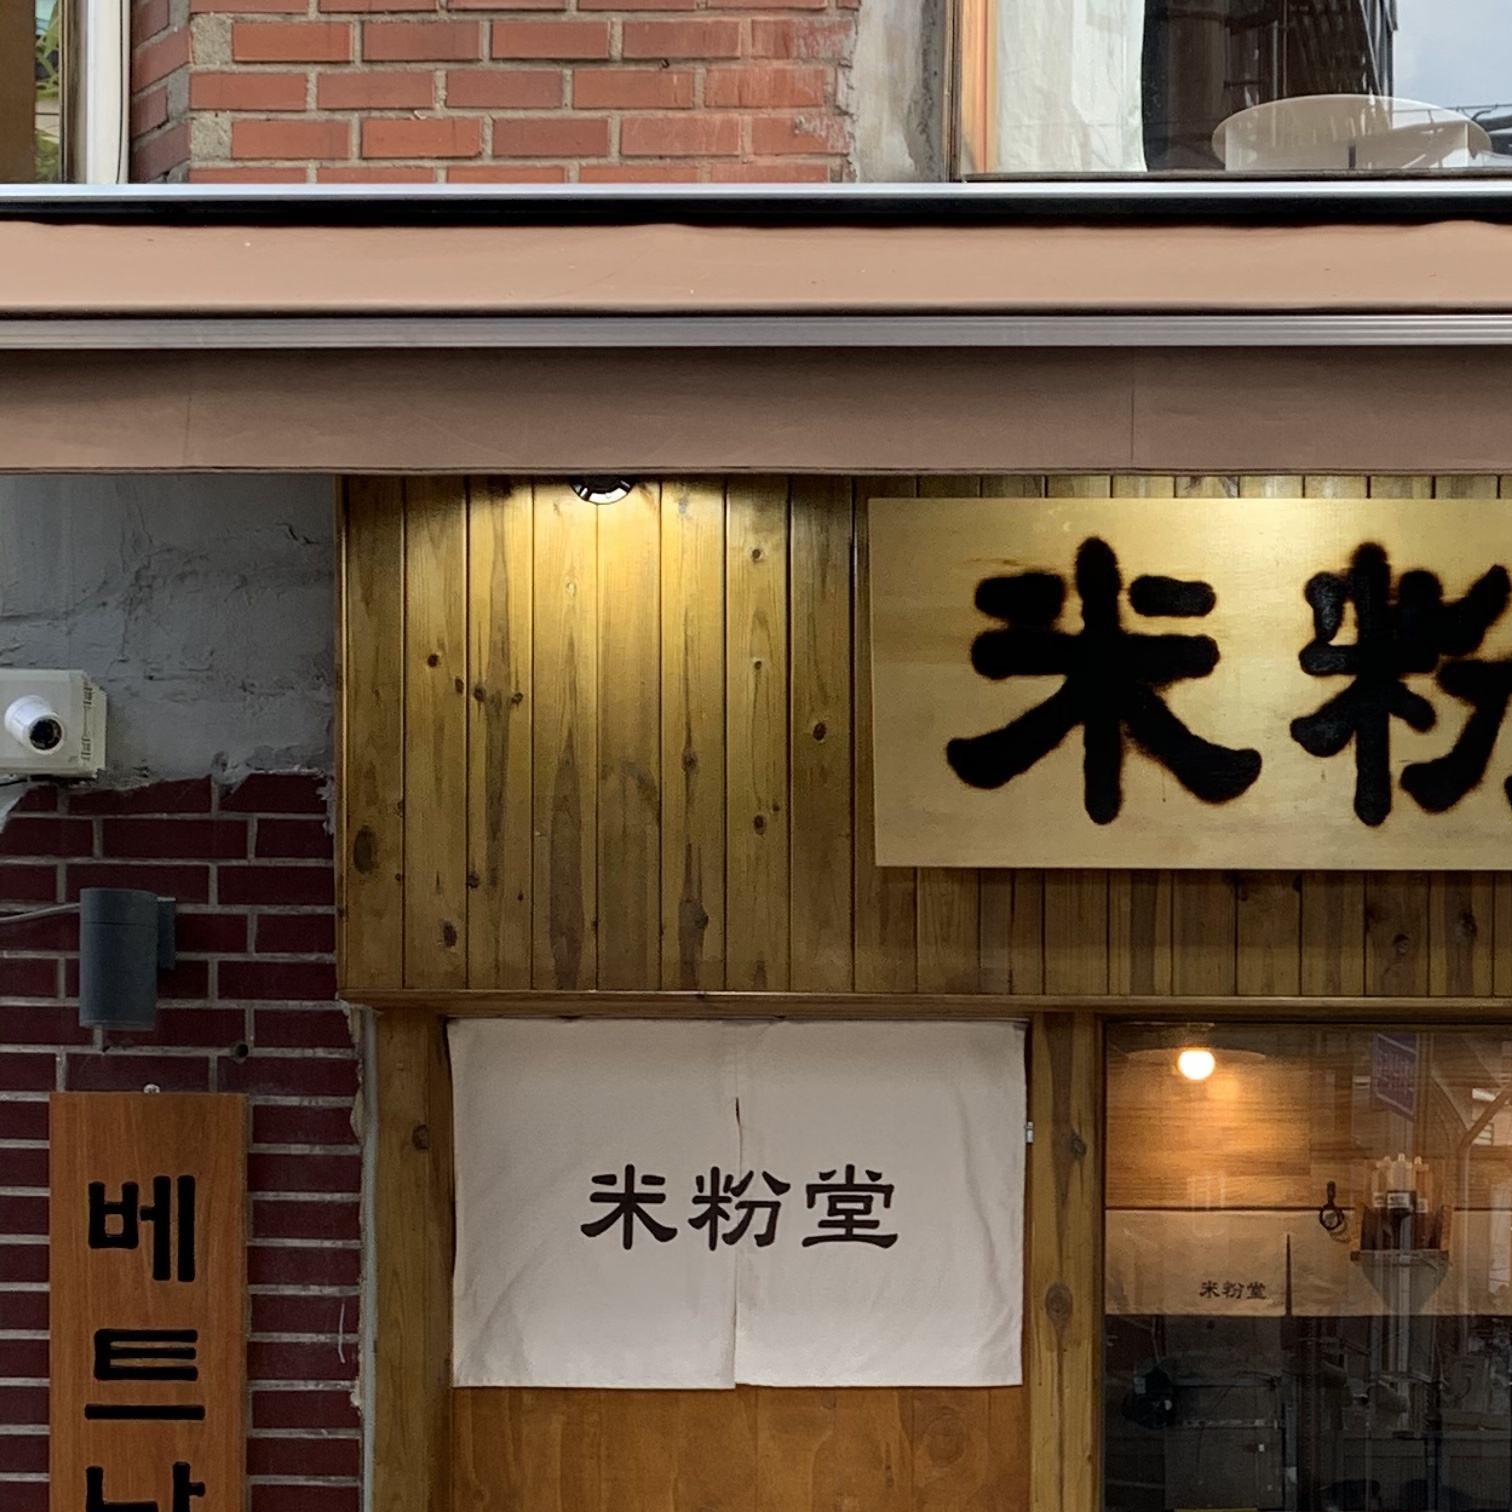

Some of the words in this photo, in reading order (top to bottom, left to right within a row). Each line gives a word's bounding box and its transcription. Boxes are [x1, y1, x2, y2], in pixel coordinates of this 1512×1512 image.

[580, 1164, 898, 1251] 米粉堂
[1199, 1280, 1267, 1299] 米粉堂
